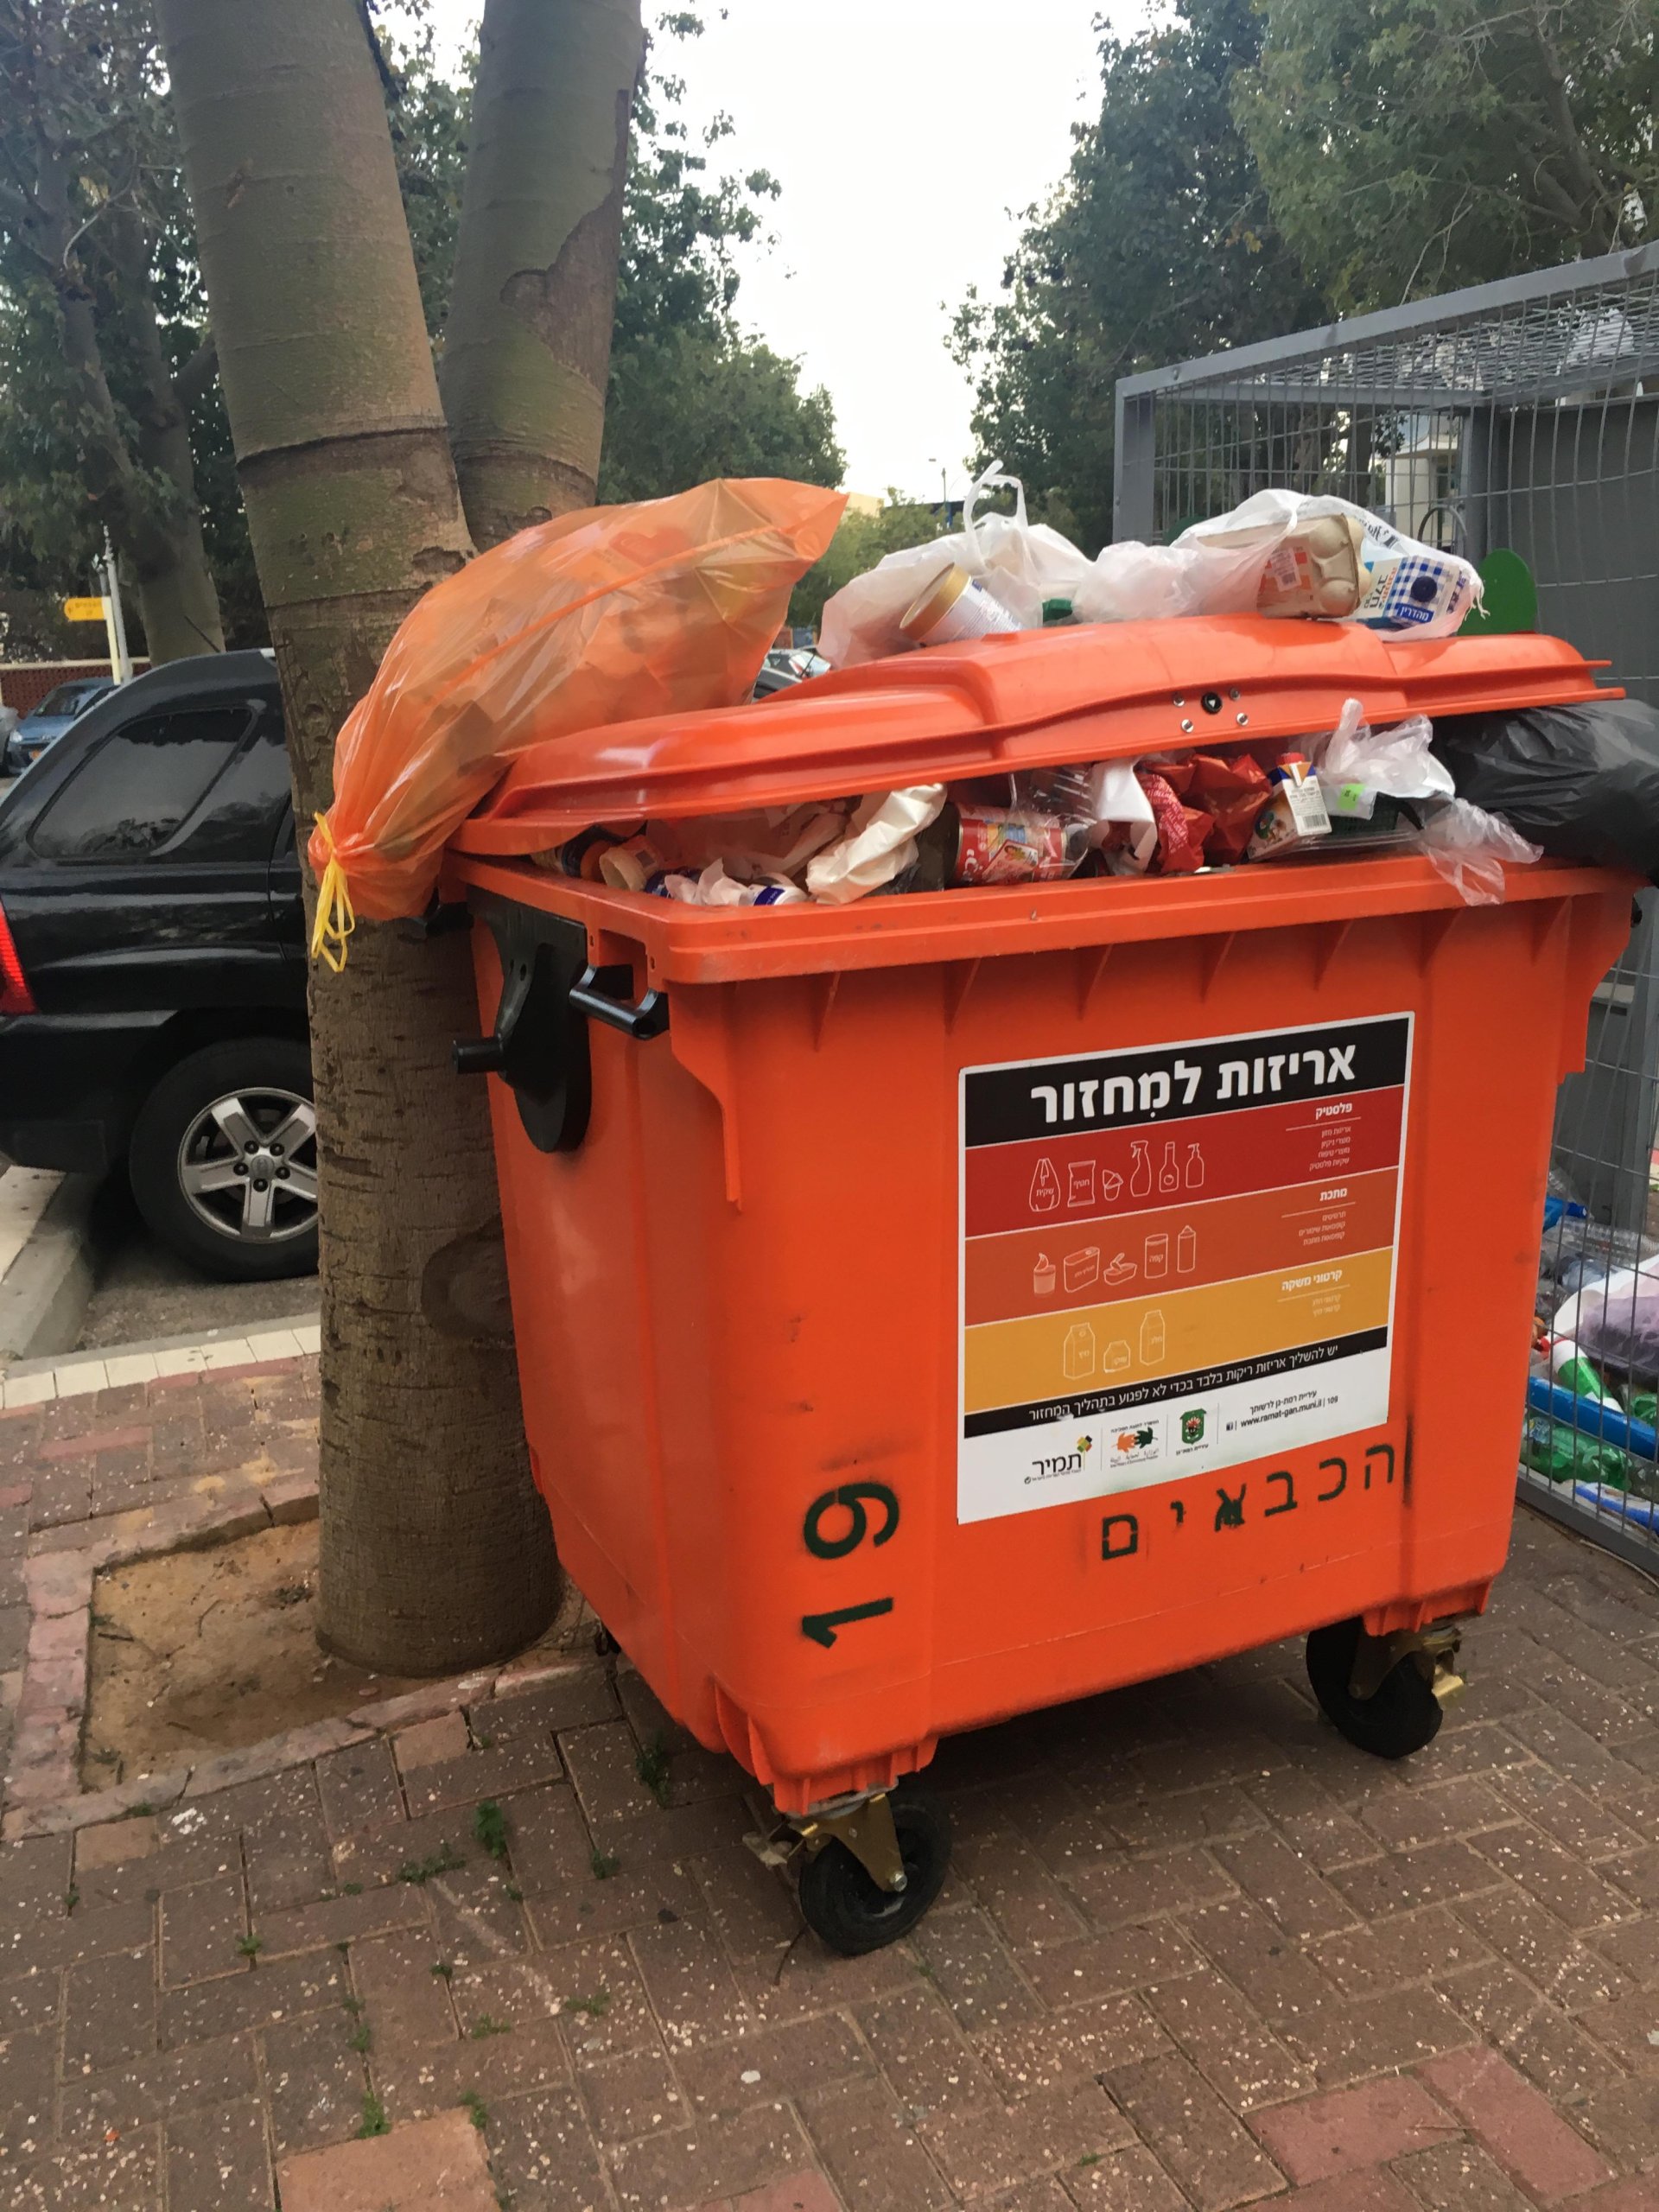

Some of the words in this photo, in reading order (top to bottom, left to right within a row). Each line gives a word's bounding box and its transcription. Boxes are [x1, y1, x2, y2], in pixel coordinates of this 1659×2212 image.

[1217, 1045, 1356, 1100] אריזות
[1315, 1103, 1353, 1120] פלסטיק
[1319, 1187, 1348, 1202] מתכת
[1281, 1276, 1312, 1292] משקה
[1313, 1269, 1343, 1283] קרטוני
[1289, 1346, 1325, 1368] להשליך
[1327, 1344, 1338, 1356] יש
[1226, 1365, 1253, 1382] ריקות
[1255, 1357, 1287, 1374] אריזות
[1170, 1379, 1193, 1393] בכדי
[1196, 1372, 1223, 1388] בלבד
[1118, 1388, 1149, 1405] לפגוע
[1152, 1383, 1167, 1397] לא
[1028, 1404, 1071, 1421] המחזור
[1073, 1395, 1116, 1415] בתהליך
[1241, 1399, 1322, 1427] www.ramat-gan.muni.il
[1249, 1400, 1274, 1415] לרשותך
[1032, 1453, 1082, 1475] תמיר
